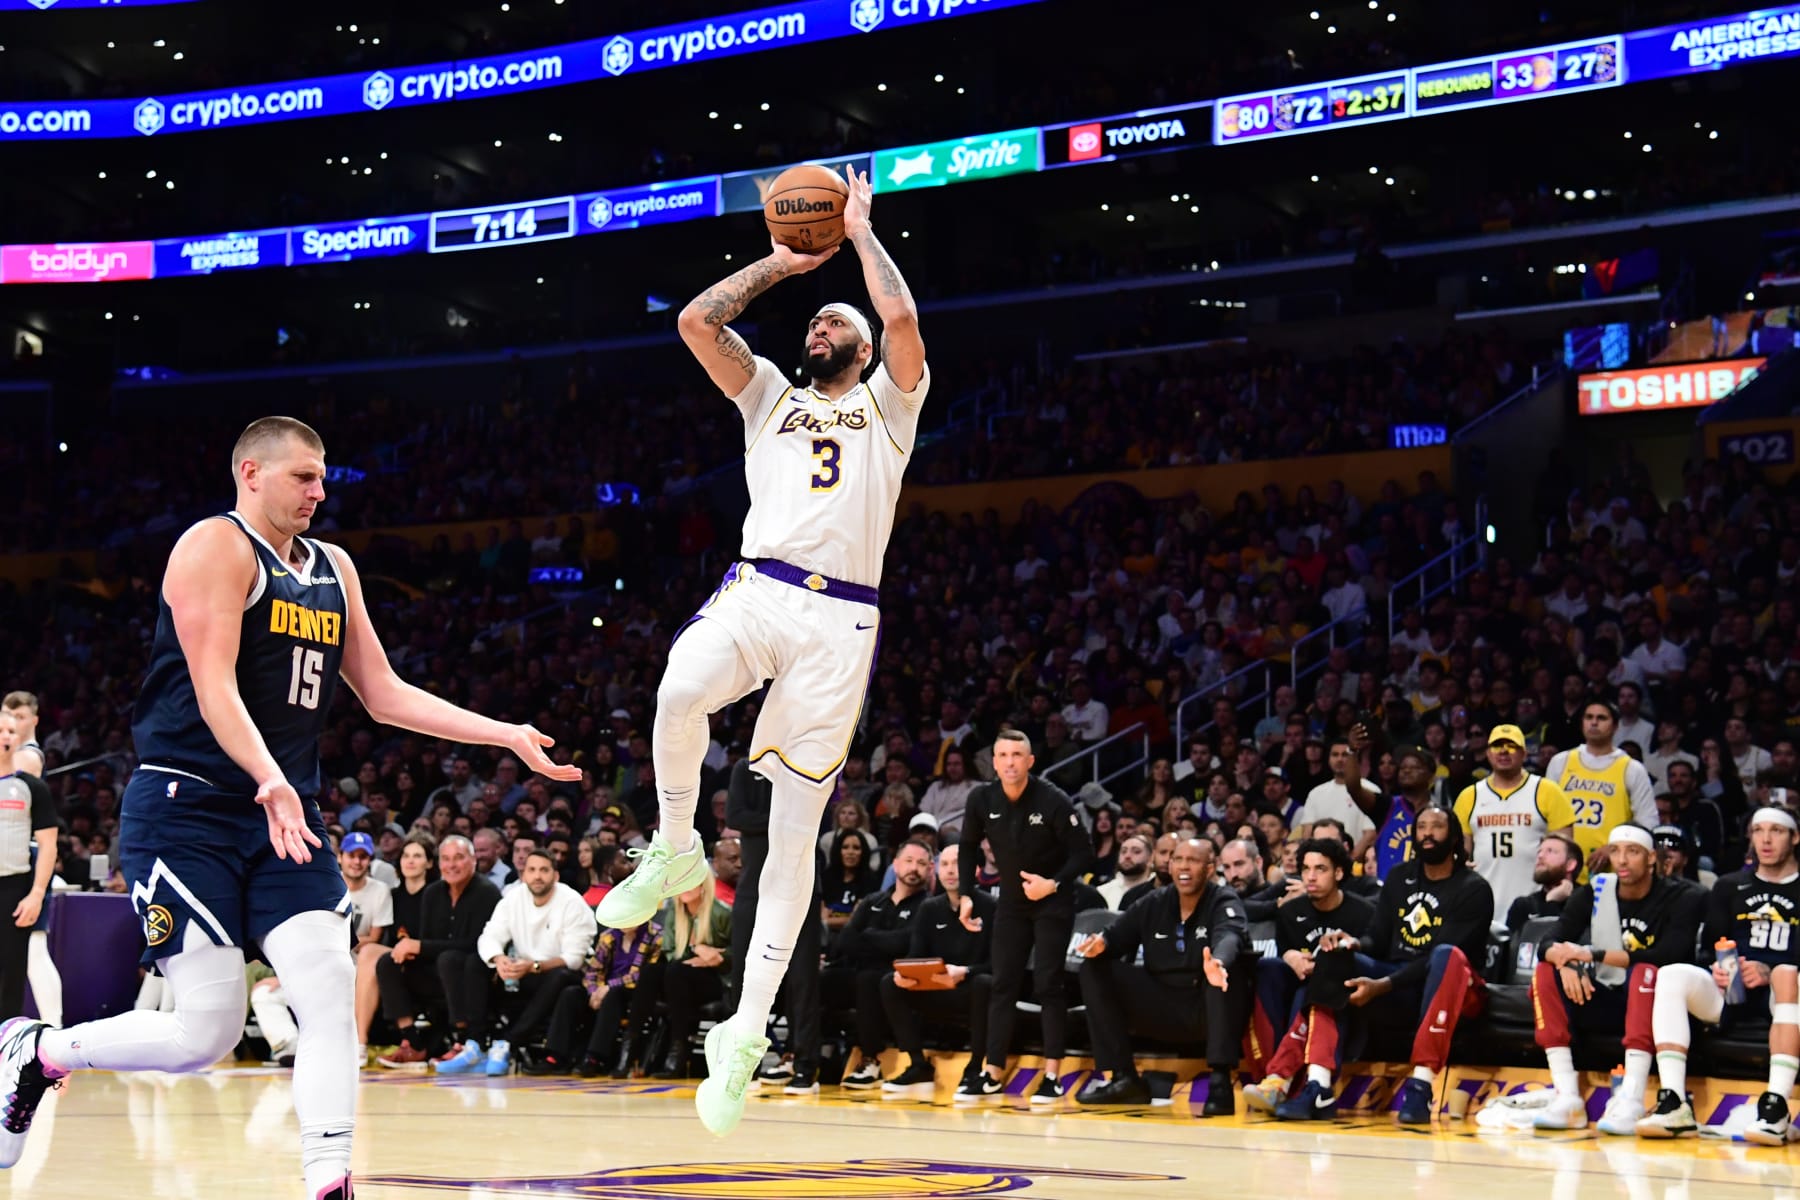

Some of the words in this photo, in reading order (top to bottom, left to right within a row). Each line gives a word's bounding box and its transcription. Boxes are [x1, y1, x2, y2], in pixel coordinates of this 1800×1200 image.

[892, 0, 992, 17] cryp
[640, 12, 805, 62] crypto.com
[1670, 12, 1800, 51] AMERICAN
[1689, 31, 1800, 66] EXPRESS
[401, 56, 563, 99] crypto.com
[1501, 63, 1534, 90] 33
[1565, 53, 1597, 81] 27
[1347, 83, 1404, 115] 2:37
[1417, 72, 1491, 98] REBOUNDS
[171, 87, 323, 127] crypto.com
[1238, 104, 1269, 131] 80
[1292, 96, 1324, 123] 72
[1106, 119, 1185, 147] TOYOTA
[947, 139, 1022, 177] Sprite
[614, 191, 703, 217] crypto.com
[774, 197, 834, 217] Wilson
[471, 208, 537, 242] 7:14
[181, 237, 259, 257] AMERICAN
[302, 225, 410, 259] Spectrum
[28, 248, 127, 279] boldyn
[191, 251, 260, 270] EXPRESS
[810, 437, 843, 492] 3
[269, 599, 341, 646] DENVER
[288, 645, 324, 710] 15
[1564, 775, 1616, 796] LAKERS
[1477, 813, 1532, 828] NUGGETS
[1572, 798, 1603, 825] 23
[1491, 832, 1513, 858] 15
[1749, 920, 1791, 951] 50
